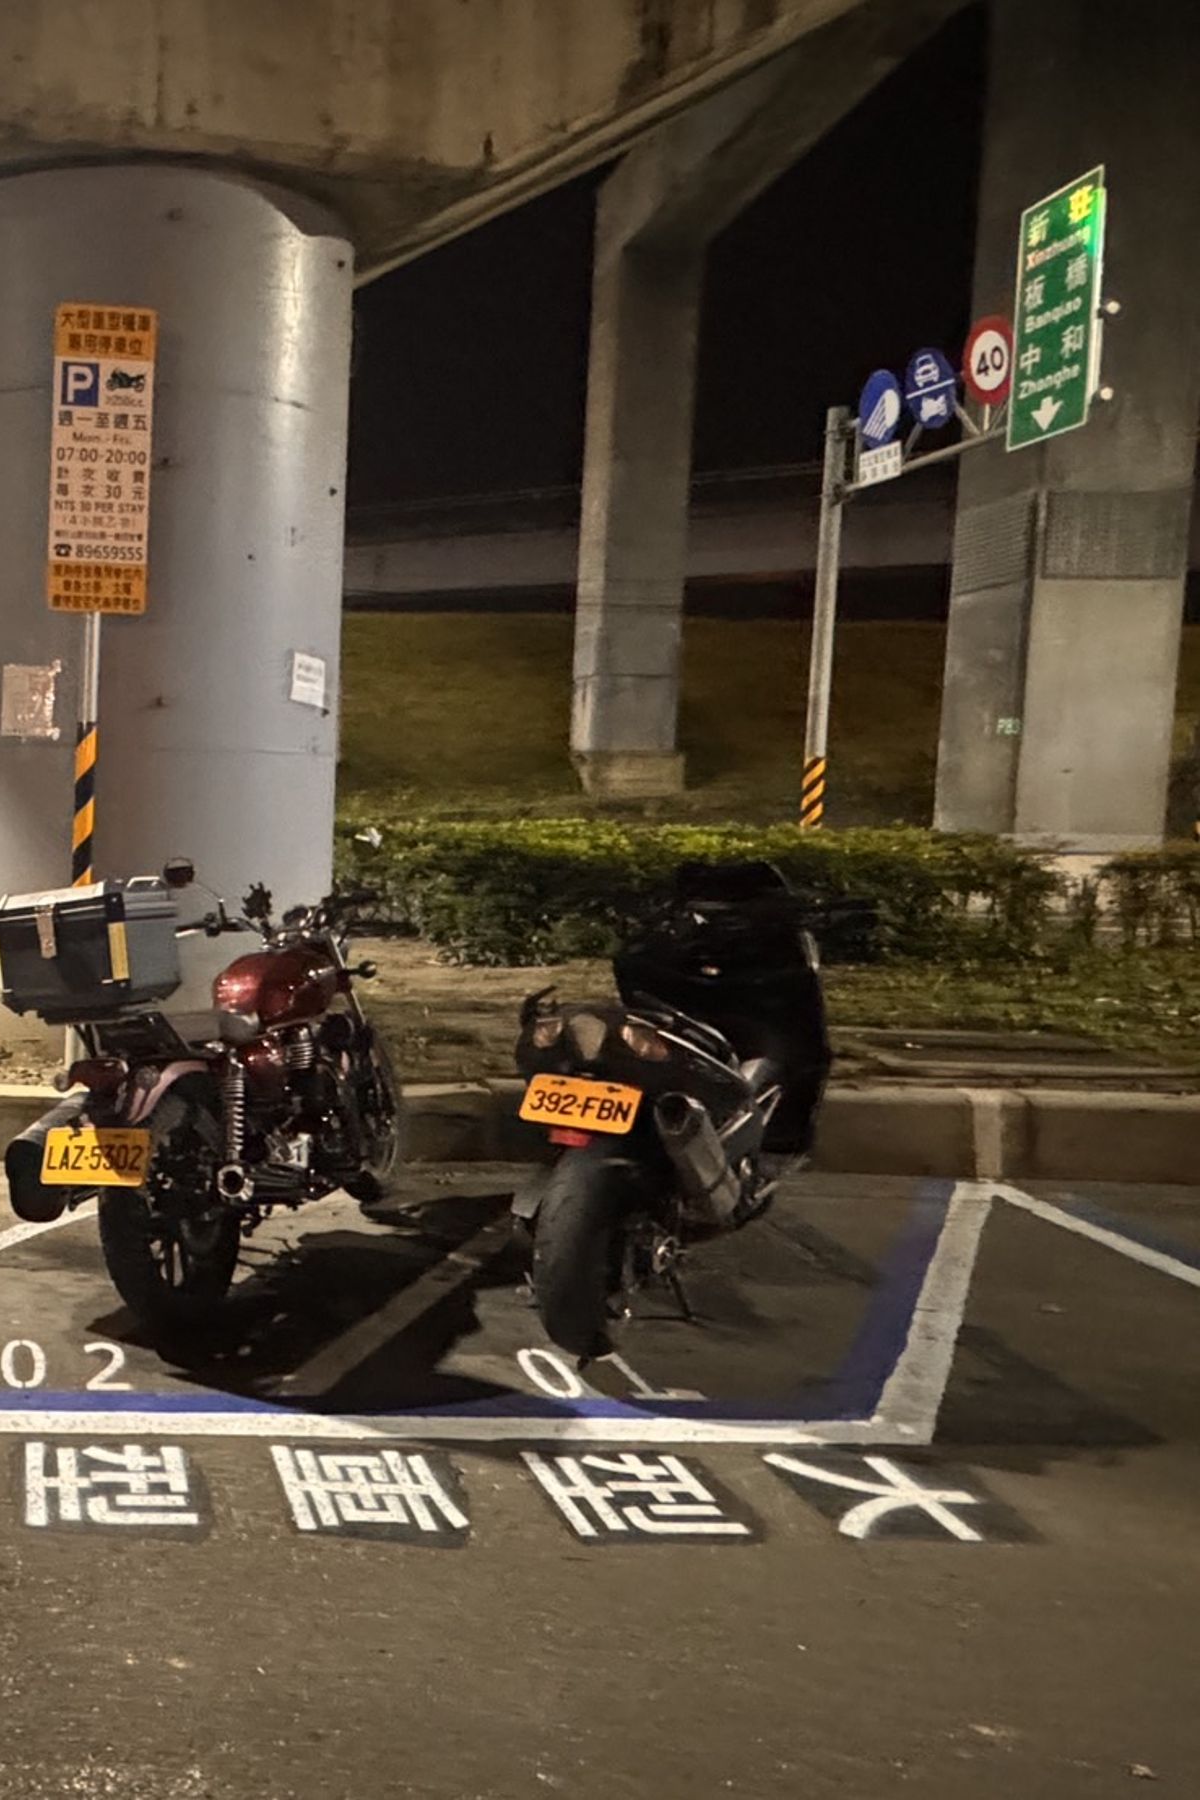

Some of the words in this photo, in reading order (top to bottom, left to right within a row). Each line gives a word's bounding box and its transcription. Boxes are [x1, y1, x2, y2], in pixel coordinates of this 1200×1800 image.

[1024, 252, 1088, 313] 板橋
[1024, 296, 1082, 334] Banqiao
[976, 345, 1005, 377] 40
[1019, 324, 1085, 375] 中和
[66, 365, 94, 403] P
[94, 502, 114, 513] PER
[529, 1089, 632, 1123] 392-FBN
[46, 1145, 143, 1171] LAZ-5302
